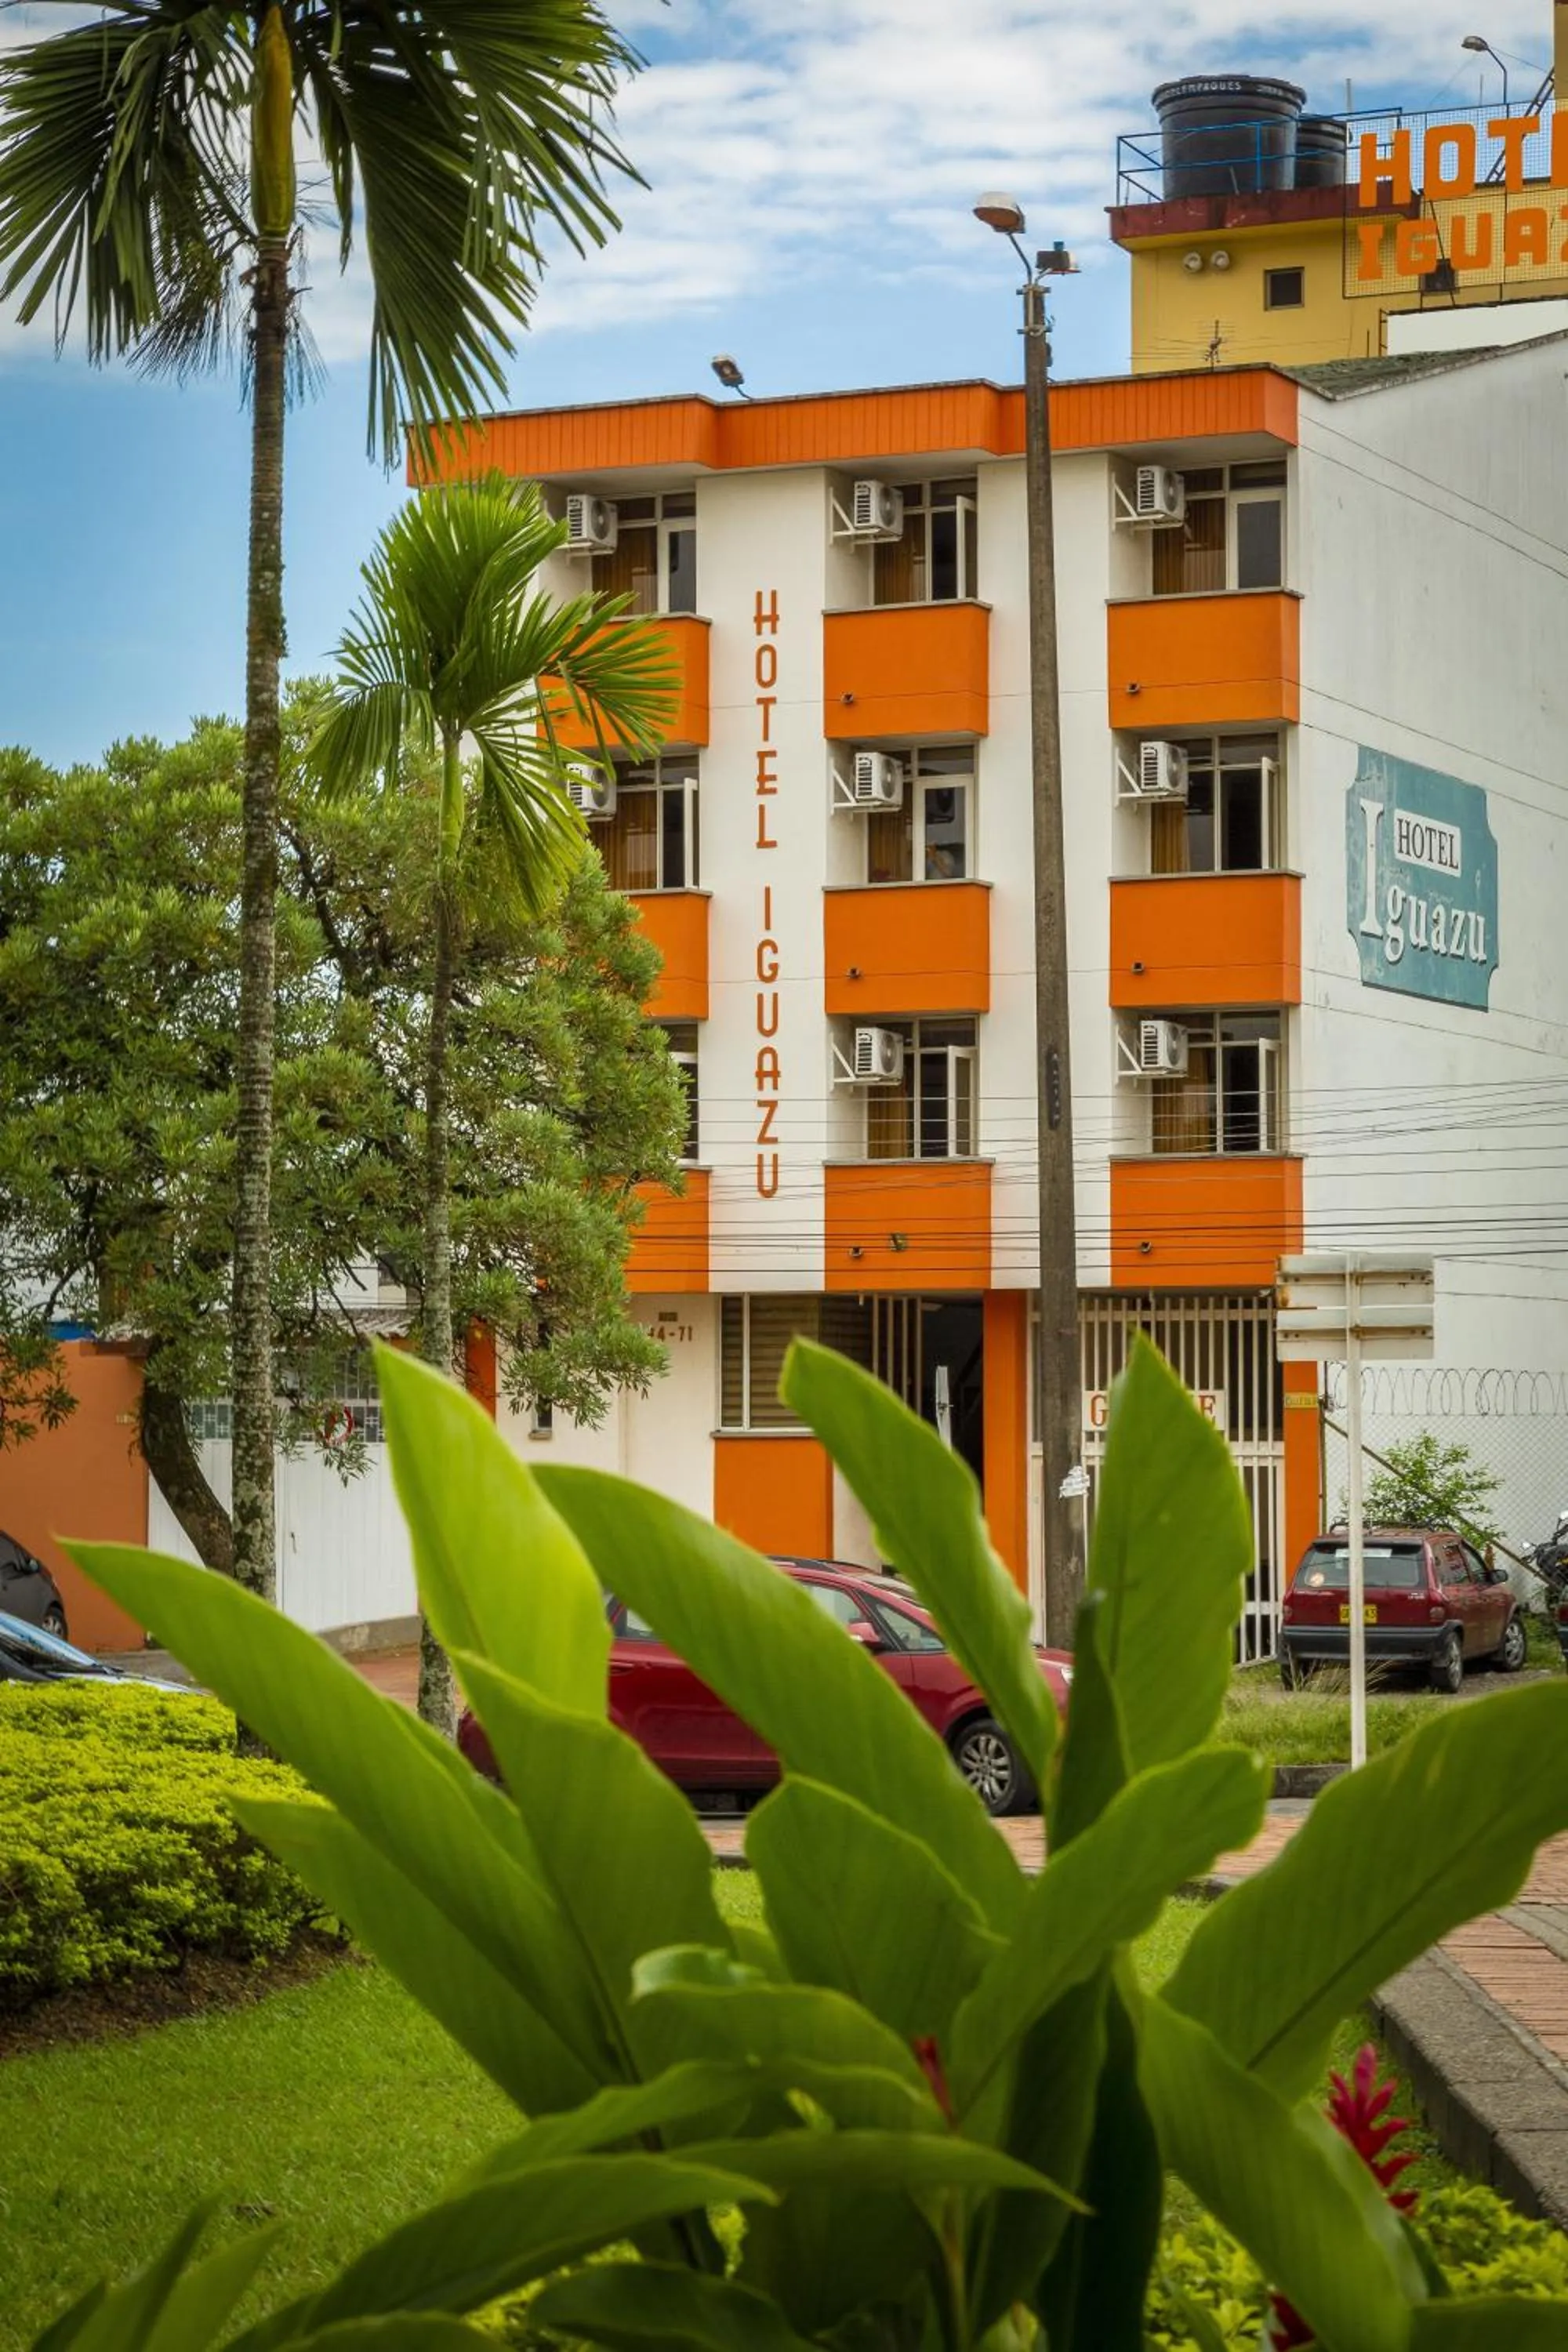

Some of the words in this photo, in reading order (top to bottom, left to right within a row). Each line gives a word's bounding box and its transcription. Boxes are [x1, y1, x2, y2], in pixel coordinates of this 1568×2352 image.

[753, 590, 779, 849] HOTEL
[1359, 797, 1487, 965] Iguazu
[1397, 818, 1459, 870] HOTEL
[755, 886, 781, 1199] IGUAZU
